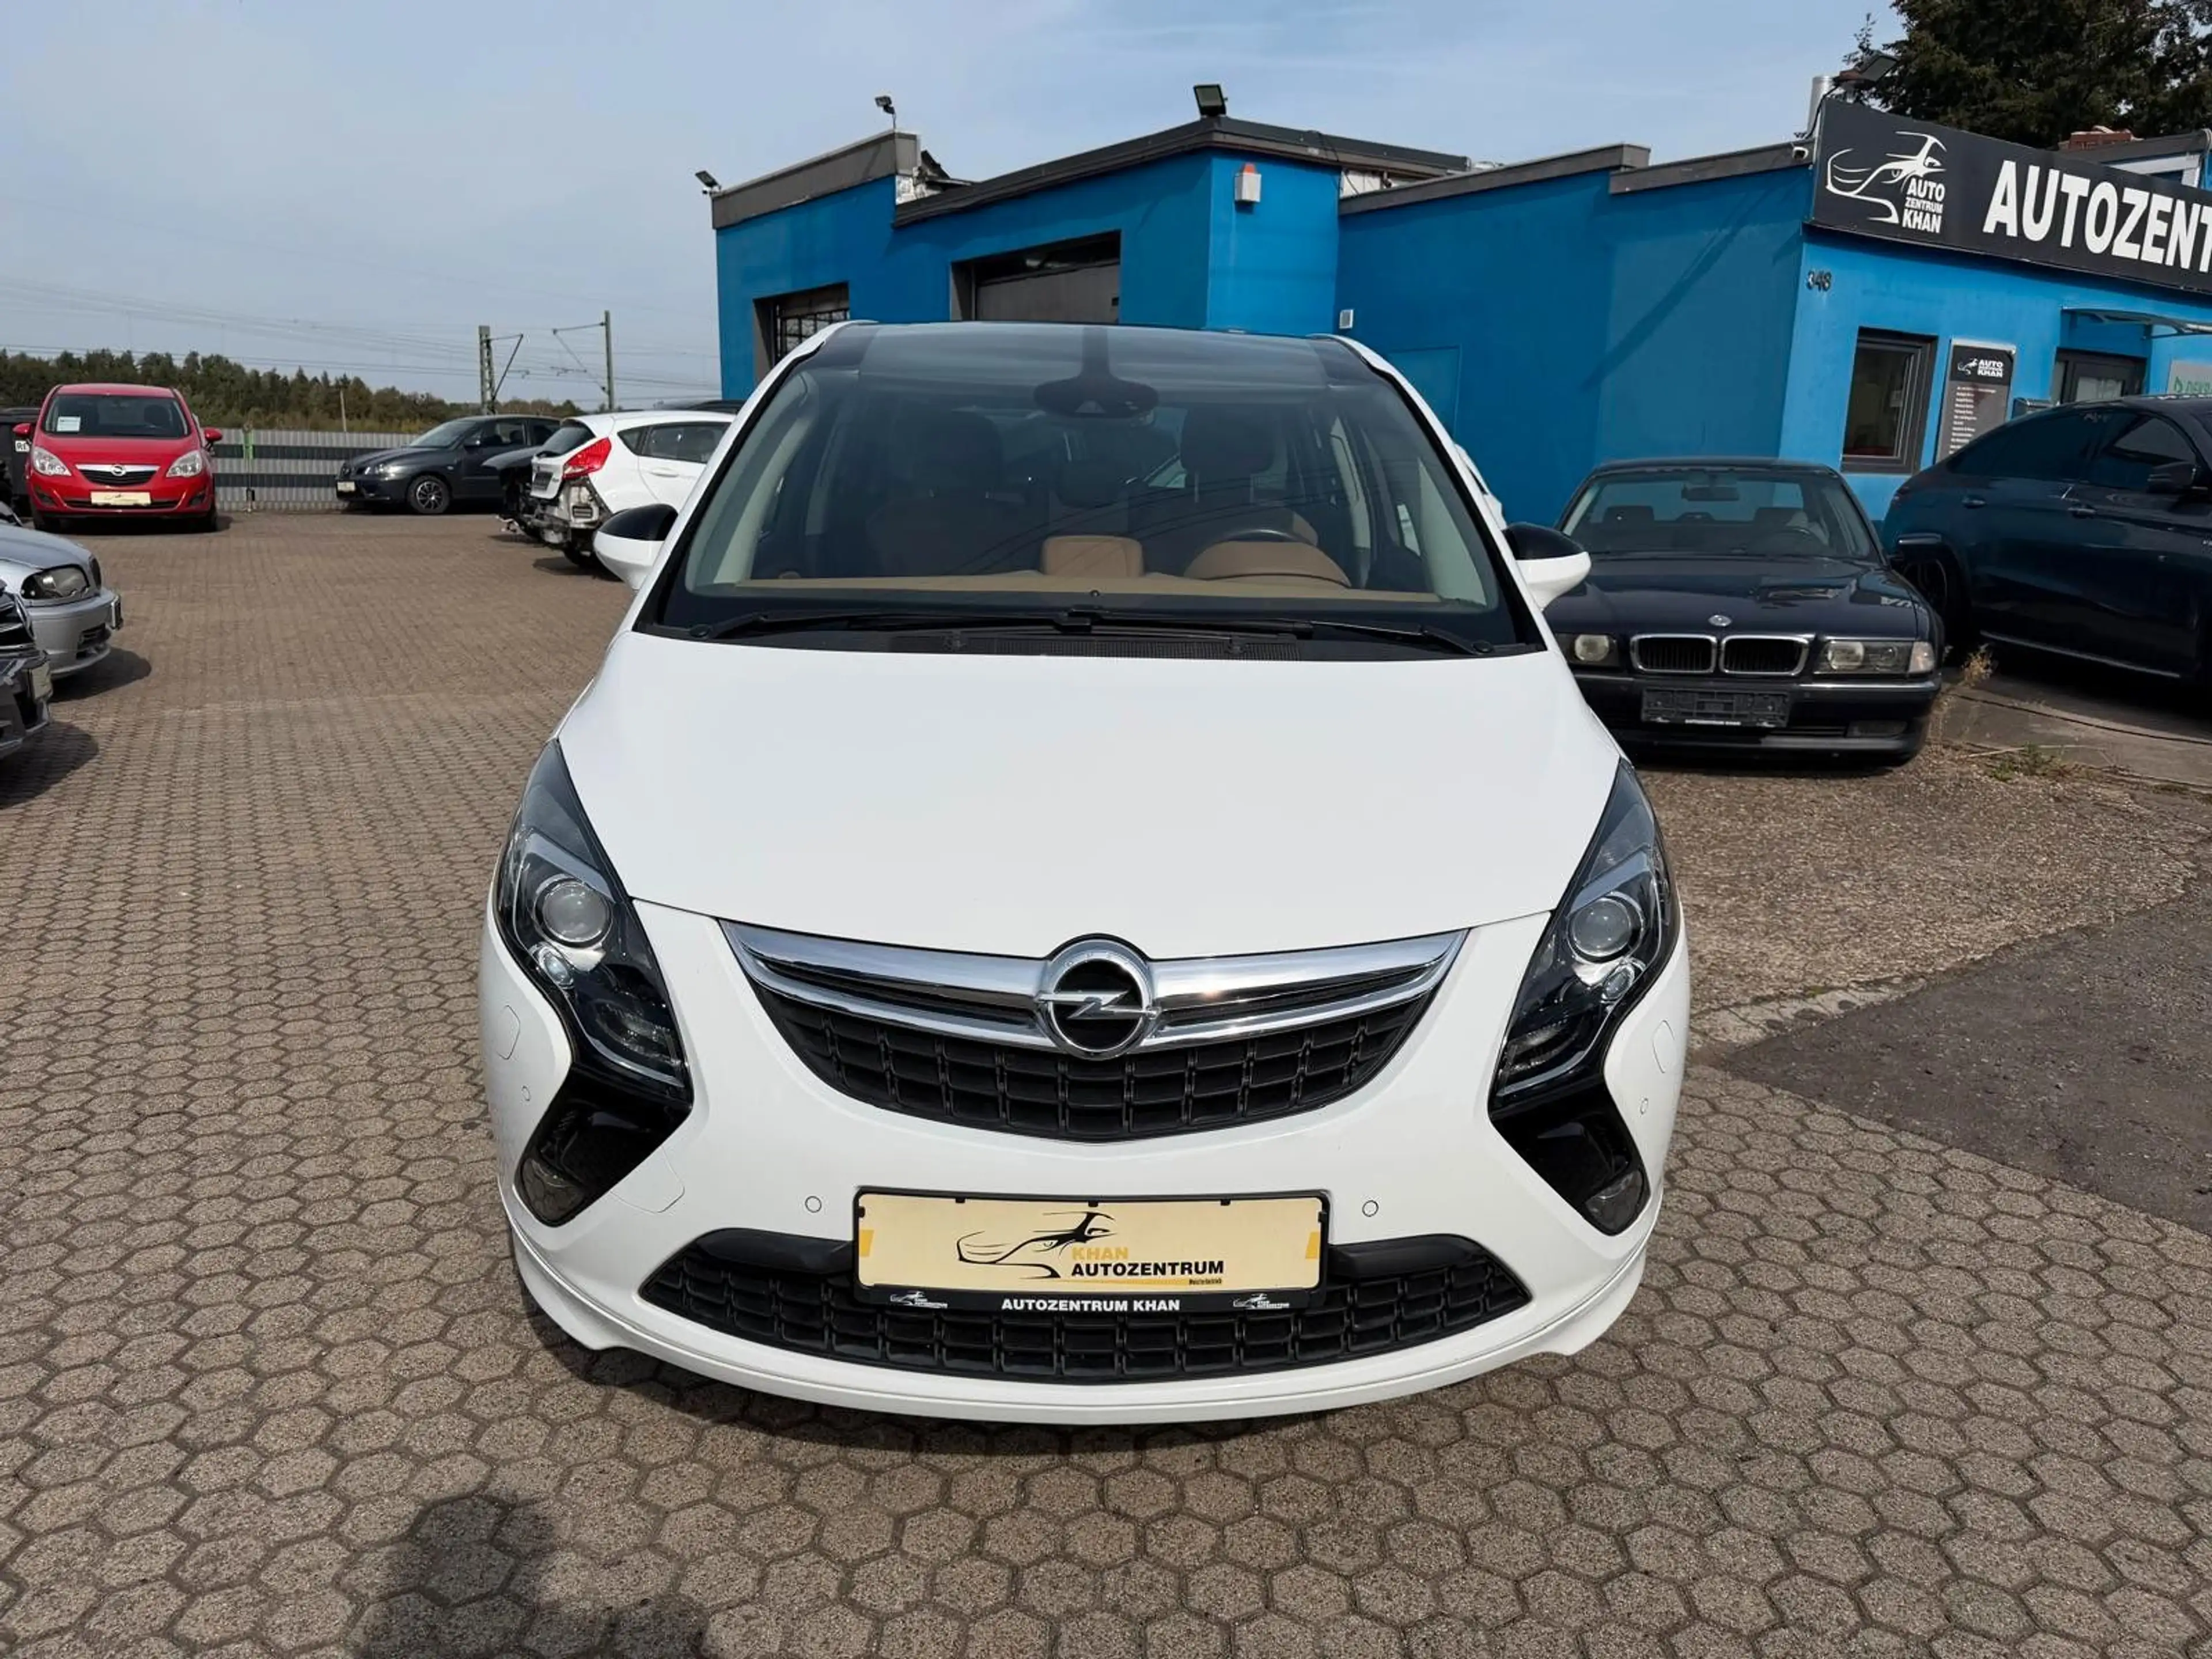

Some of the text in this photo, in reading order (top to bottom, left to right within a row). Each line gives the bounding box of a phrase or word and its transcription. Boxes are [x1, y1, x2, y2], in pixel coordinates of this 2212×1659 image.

[1907, 177, 1945, 202] AUTO
[1905, 196, 1944, 214] ZENTRUM
[1902, 208, 1942, 233] KHAN
[1978, 359, 2003, 368] AUTO
[1071, 1247, 1128, 1260] KHAN
[1071, 1260, 1224, 1277] AUTOZENTRUM
[1002, 1298, 1180, 1312] AUTOZENTRUM KHAN
